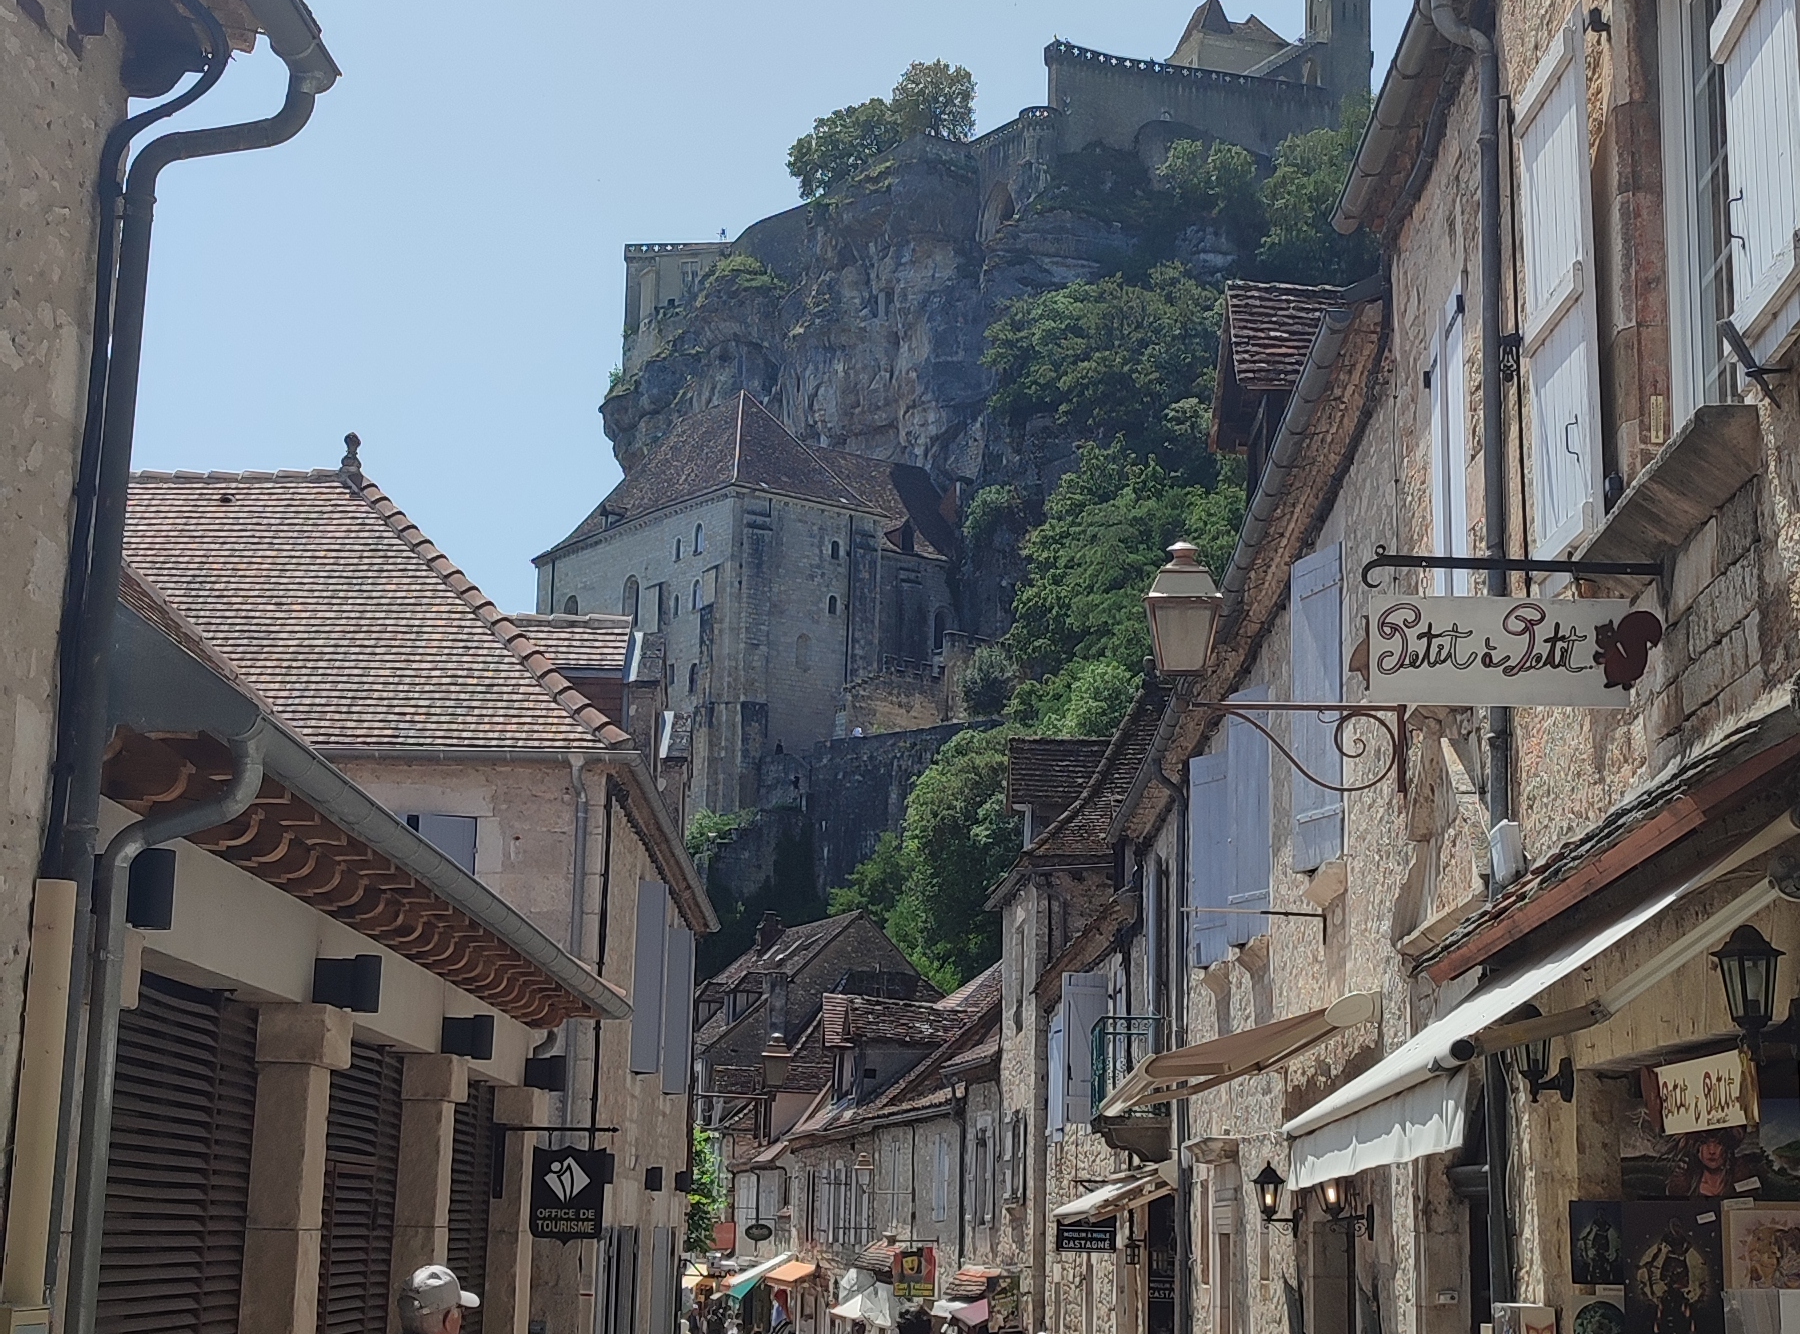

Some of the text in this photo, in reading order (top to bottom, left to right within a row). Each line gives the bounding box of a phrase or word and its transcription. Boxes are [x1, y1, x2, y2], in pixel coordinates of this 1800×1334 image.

[1377, 602, 1478, 675] Petit
[536, 1208, 596, 1219] OFFICE DE
[536, 1220, 596, 1234] TOURISME
